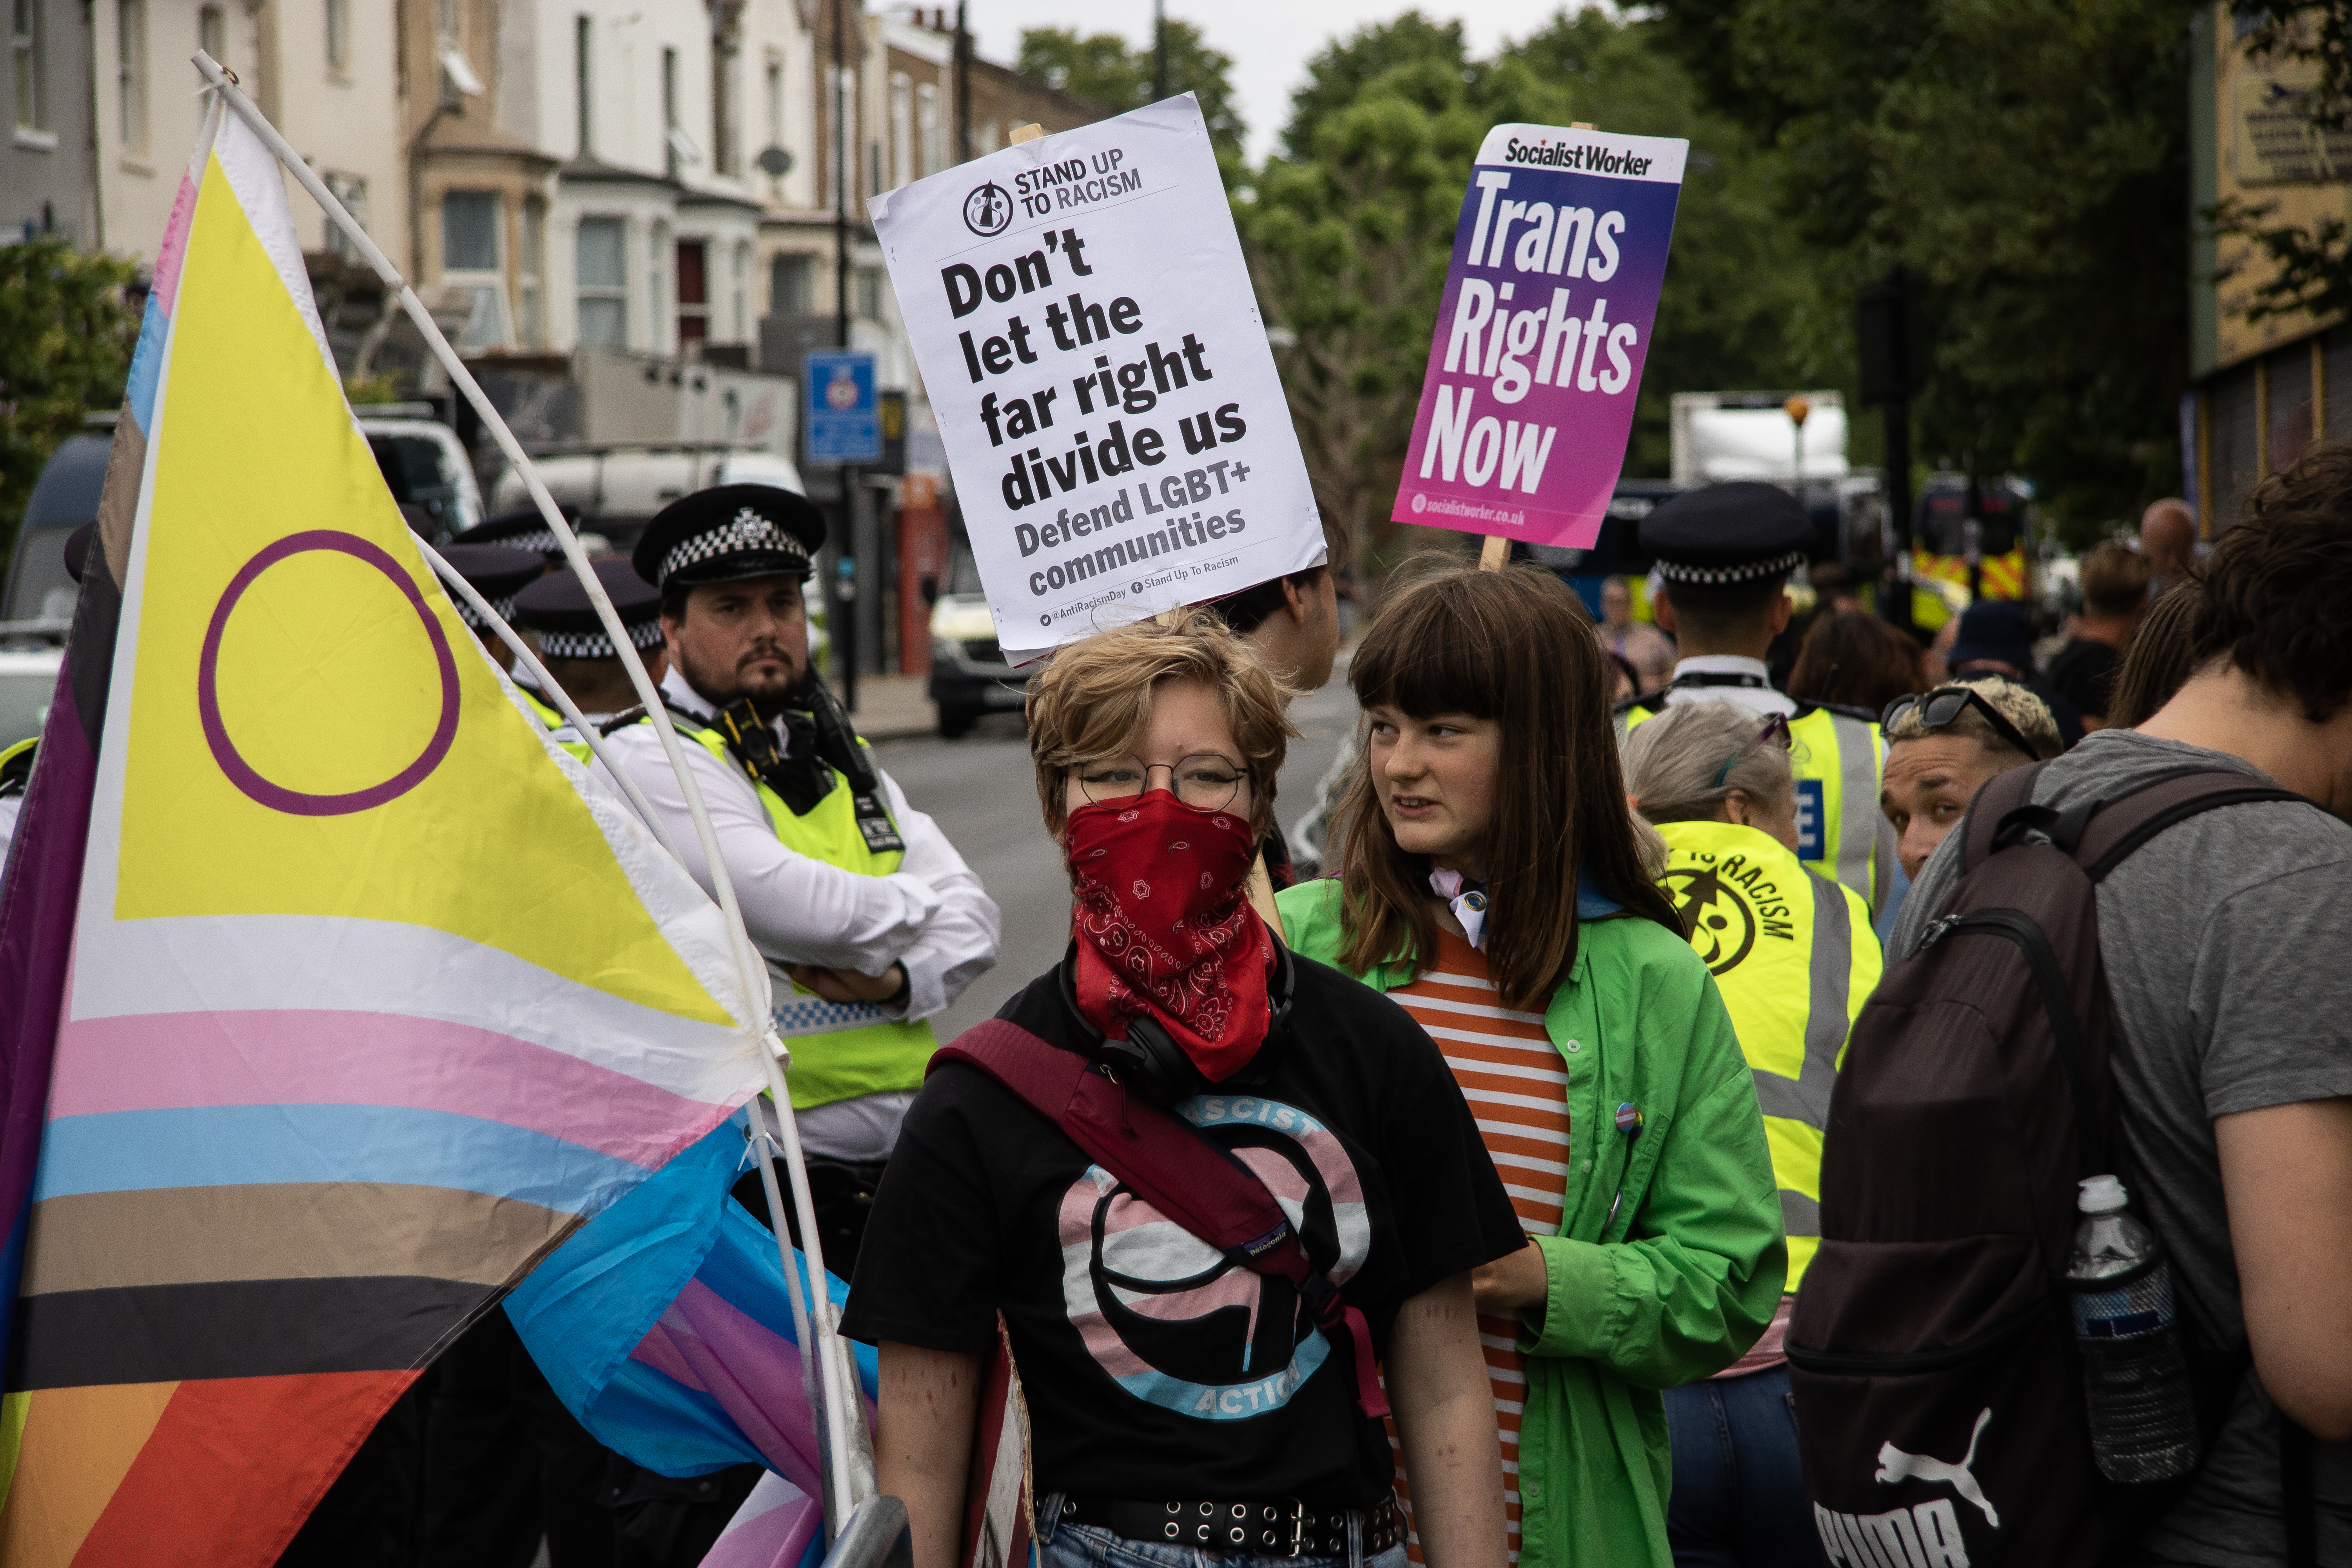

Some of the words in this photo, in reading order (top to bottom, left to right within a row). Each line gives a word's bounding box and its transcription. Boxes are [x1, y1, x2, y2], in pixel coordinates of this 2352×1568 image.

[1015, 160, 1086, 194] STAND
[1091, 149, 1123, 174] UP
[1506, 138, 1583, 169] Socialist
[1586, 146, 1652, 175] Worker
[1020, 193, 1051, 218] TO
[1055, 168, 1142, 209] RACISM
[1468, 171, 1624, 281] Trans
[958, 316, 1038, 384] let
[1045, 293, 1143, 351] the
[1444, 278, 1637, 403] Rights
[980, 386, 1056, 447] far
[1073, 333, 1213, 415] right
[1002, 420, 1167, 510] divide
[1178, 403, 1246, 455] us
[1420, 385, 1556, 493] Now
[1014, 488, 1134, 558] Defend
[1138, 460, 1250, 515] LGBT+
[1427, 499, 1525, 525] socialistworker.co.uk
[1030, 509, 1245, 596] communities
[1145, 572, 1172, 588] Stand
[1174, 569, 1188, 581] Up
[1190, 565, 1201, 576] To
[1204, 556, 1239, 572] Racism
[1052, 589, 1126, 621] @AntiRacismDay
[1721, 854, 1794, 940] RACISM
[1185, 1099, 1320, 1140] ASCIST
[1250, 1232, 1286, 1256] patagonia
[1194, 1357, 1301, 1414] ACTION
[1814, 1498, 1970, 1568] PUMA
